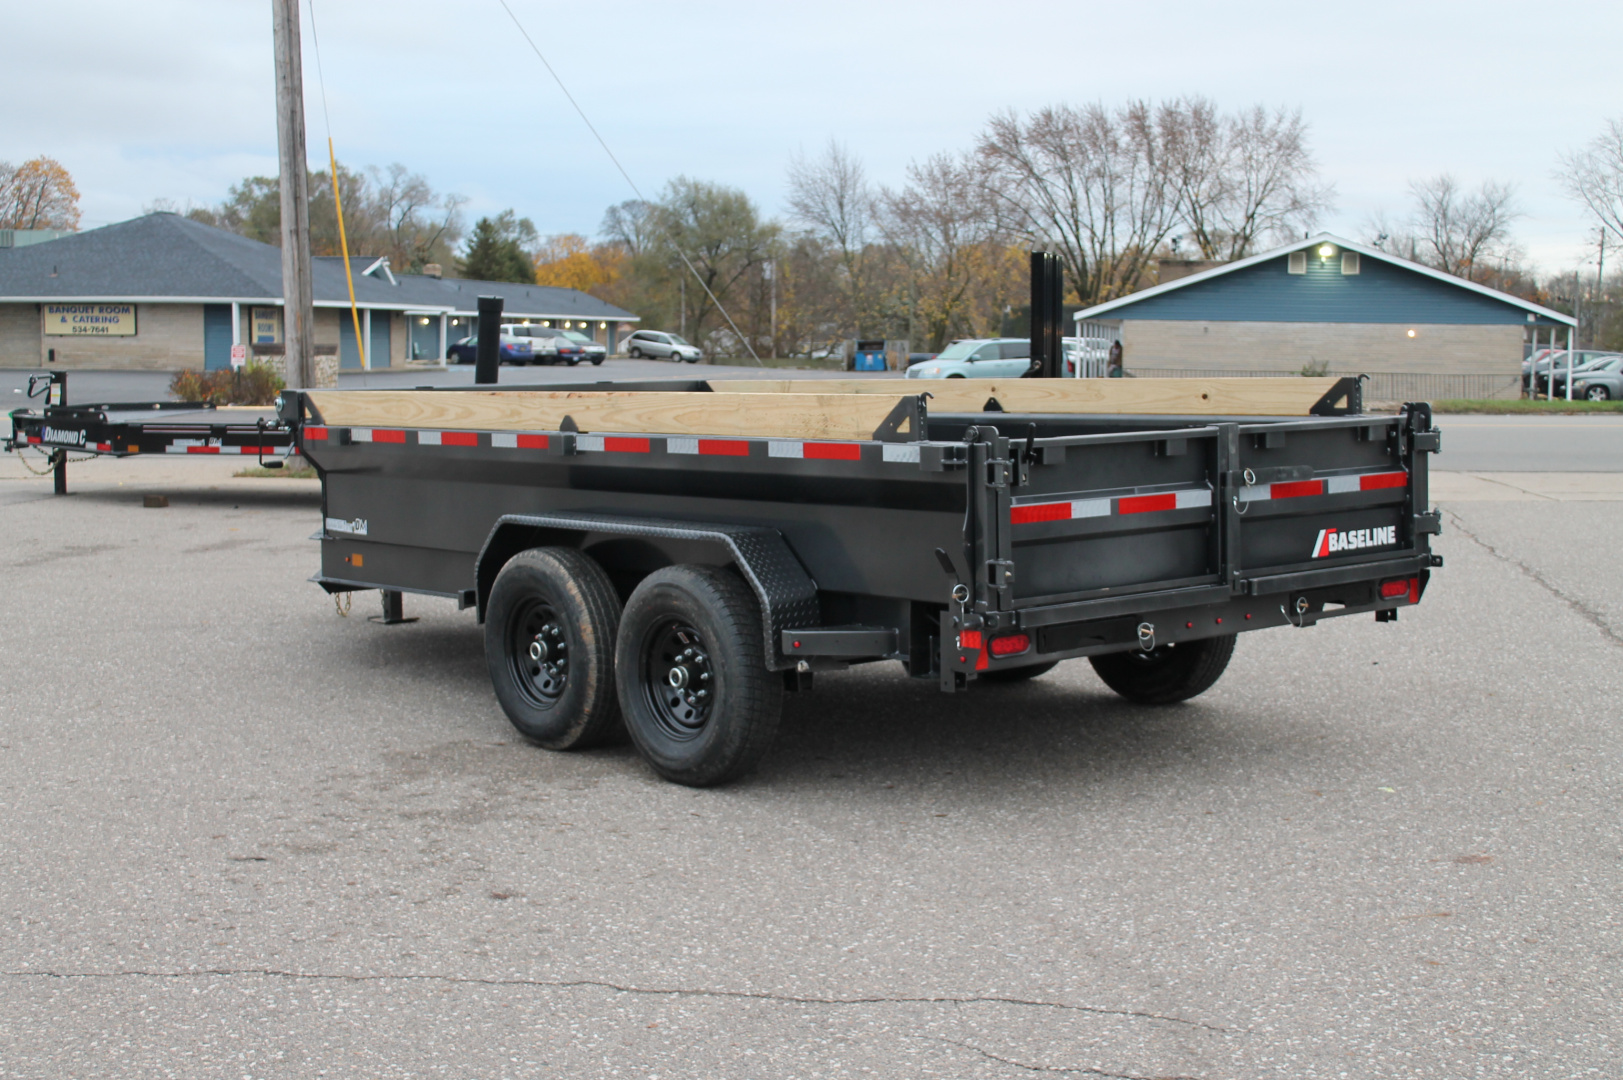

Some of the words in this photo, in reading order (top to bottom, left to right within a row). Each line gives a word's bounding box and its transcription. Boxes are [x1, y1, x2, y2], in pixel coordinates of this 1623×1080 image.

[48, 305, 95, 314] BANQUET
[98, 306, 131, 314] ROOM
[60, 315, 68, 323] &
[72, 315, 120, 324] CATERING
[79, 429, 87, 445] C
[1328, 525, 1397, 552] BASELINE
